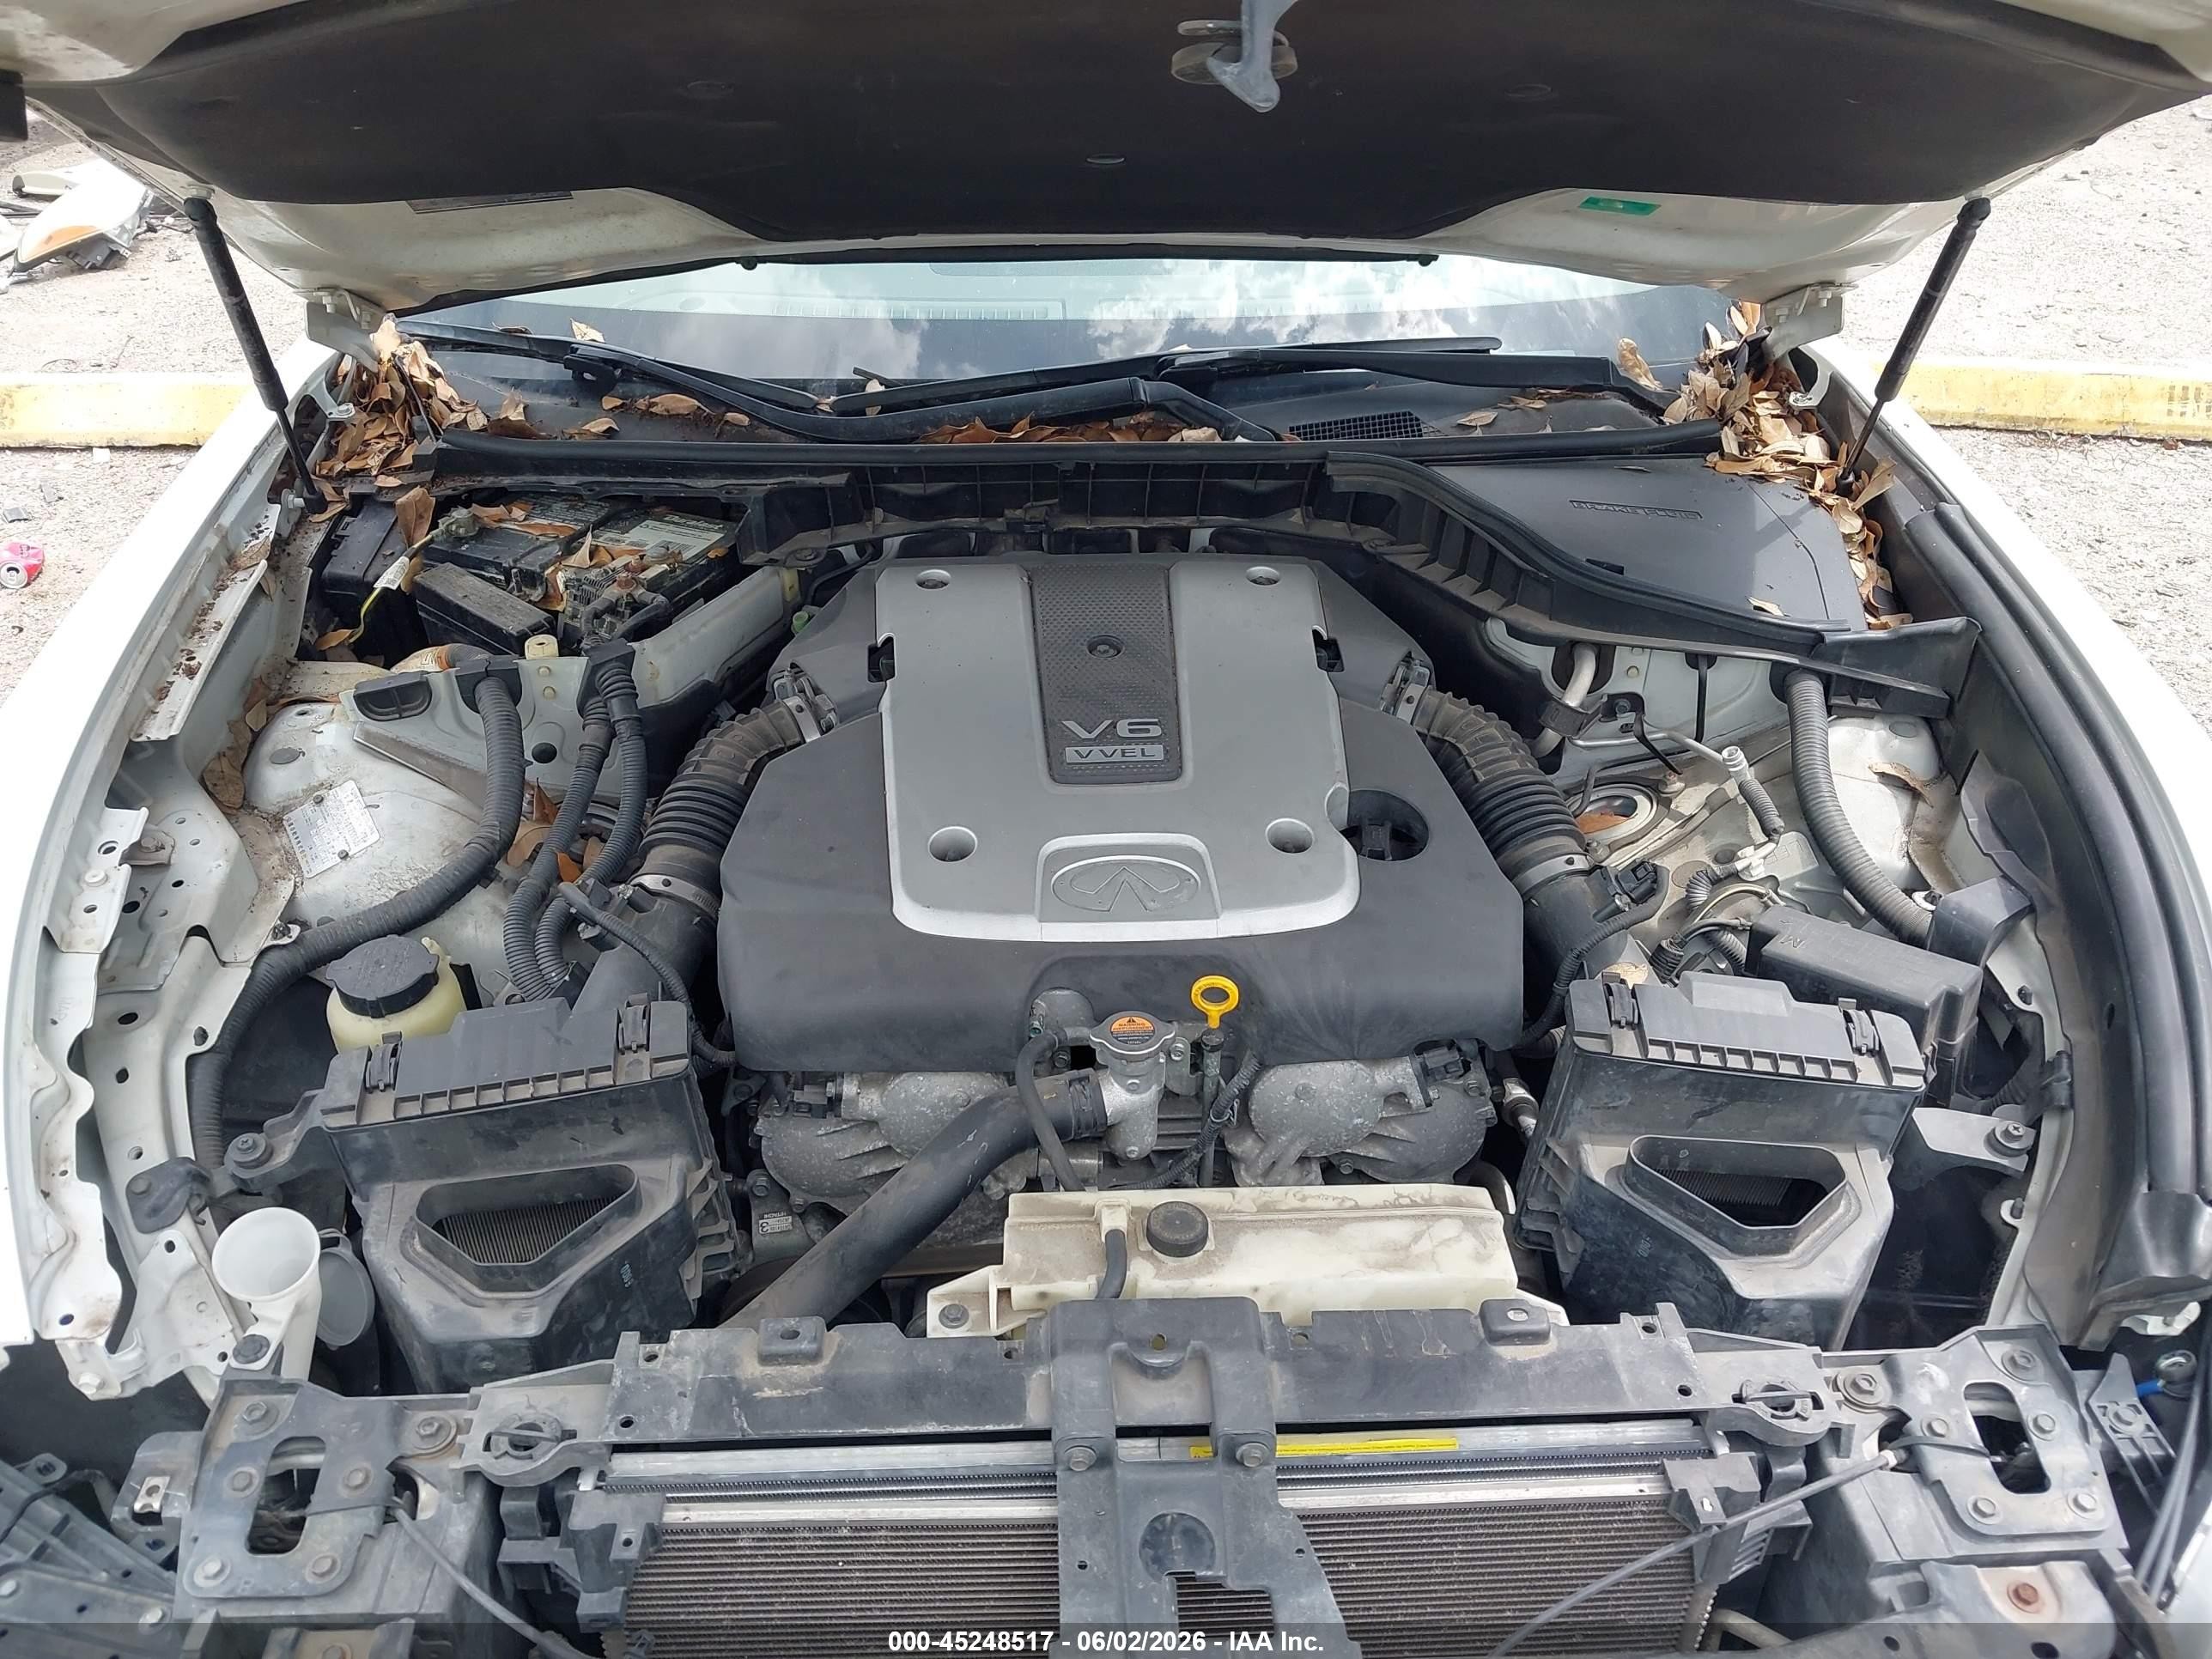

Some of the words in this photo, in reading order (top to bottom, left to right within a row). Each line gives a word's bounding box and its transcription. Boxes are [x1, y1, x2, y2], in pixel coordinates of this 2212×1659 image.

[1572, 501, 1642, 515] BRAKE
[1643, 507, 1699, 520] FLUID
[664, 514, 723, 530] Duralast
[1061, 718, 1163, 739] V6
[1073, 747, 1157, 760] VVEL
